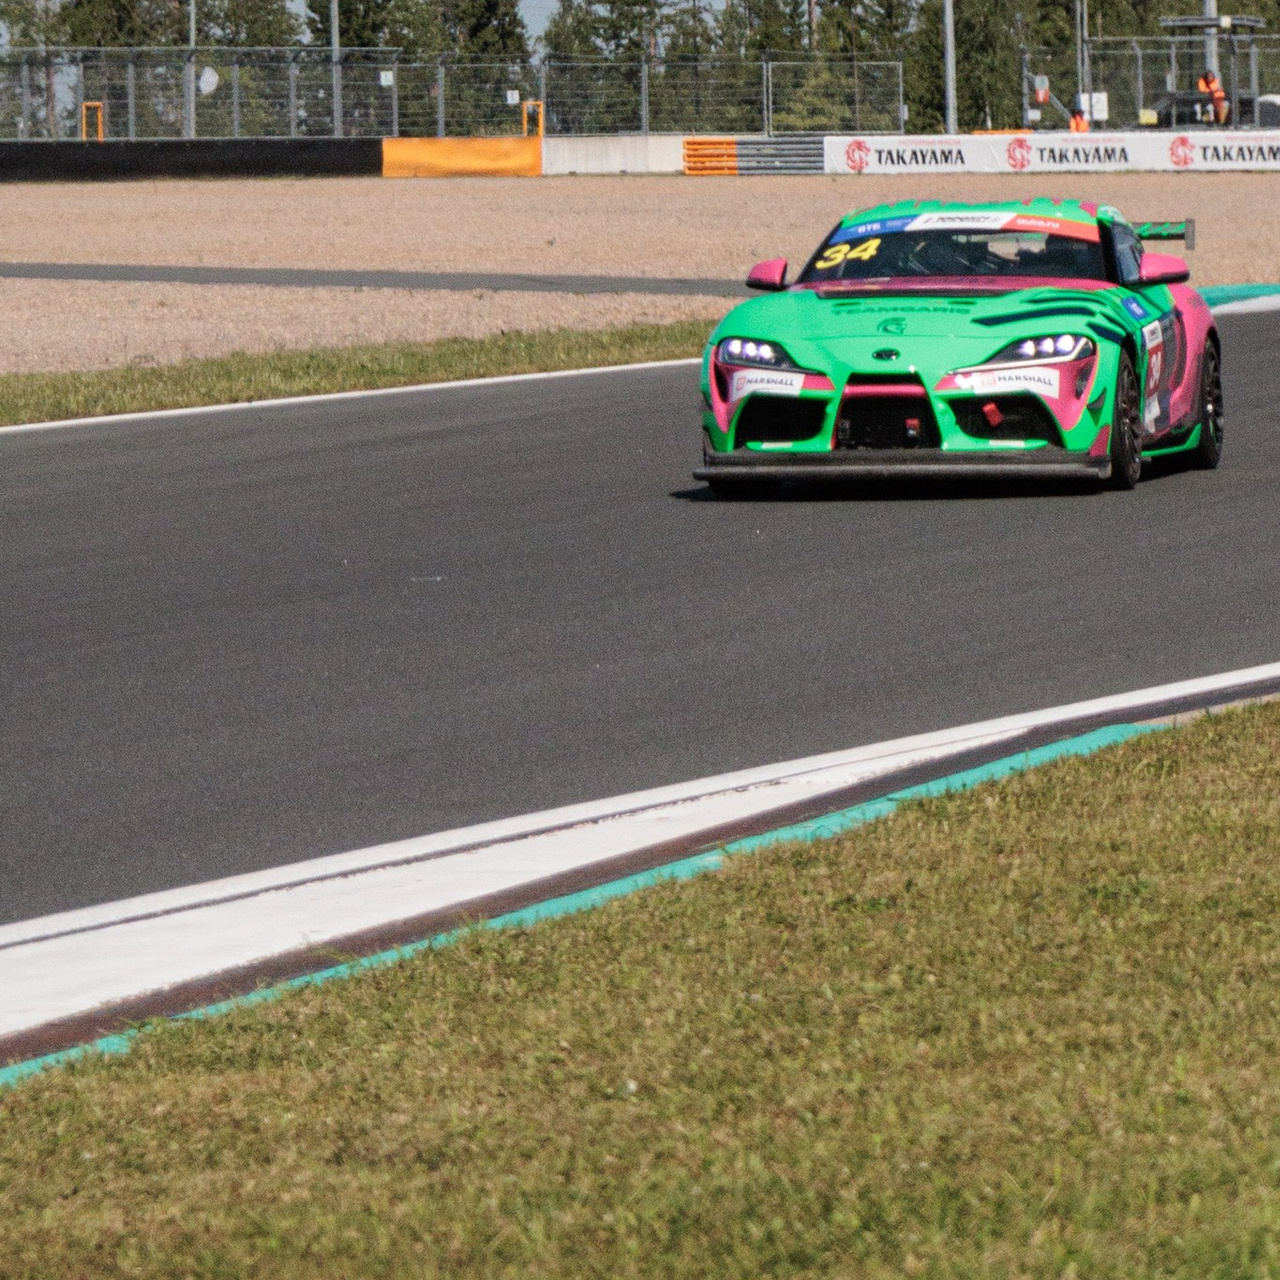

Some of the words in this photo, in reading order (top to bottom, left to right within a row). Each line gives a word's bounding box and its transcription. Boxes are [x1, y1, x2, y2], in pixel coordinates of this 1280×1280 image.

[876, 149, 964, 166] TAKAYAMA
[1038, 147, 1129, 164] TAKAYAMA
[814, 238, 881, 270] 34
[746, 377, 795, 387] MARSHALL
[998, 375, 1053, 387] MARSHALL
